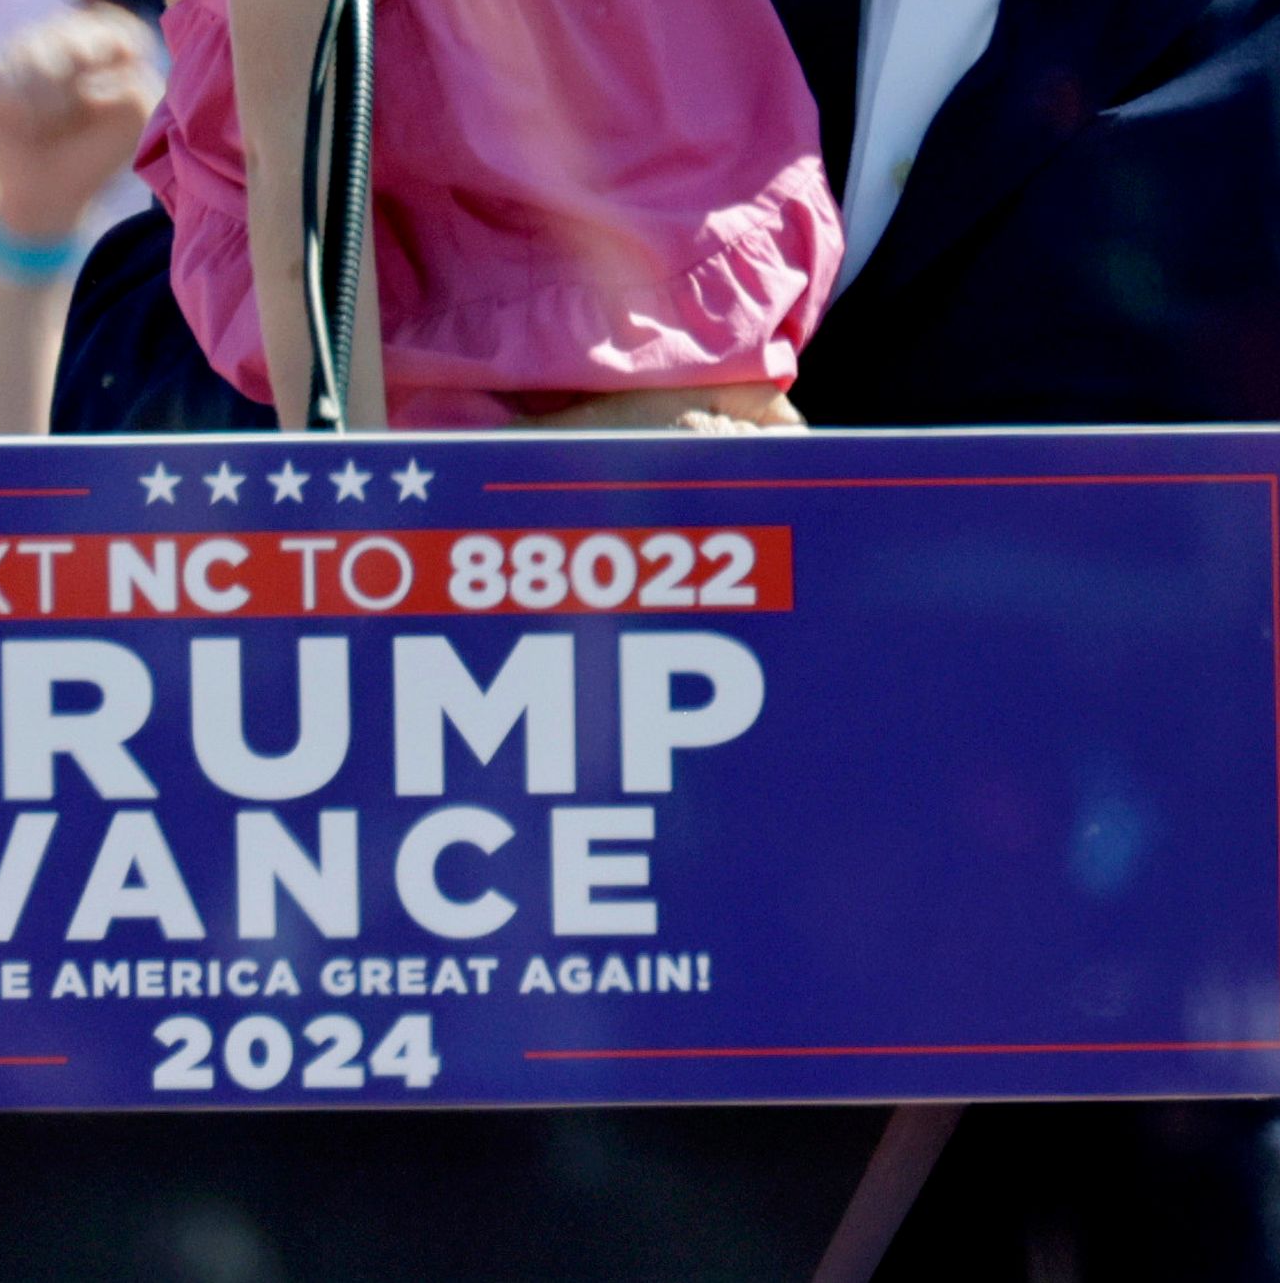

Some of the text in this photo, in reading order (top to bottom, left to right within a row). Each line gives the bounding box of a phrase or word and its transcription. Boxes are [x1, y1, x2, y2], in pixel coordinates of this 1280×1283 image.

[109, 538, 251, 613] NC
[281, 536, 413, 610] TO
[449, 533, 757, 609] 88022
[51, 958, 301, 999] AMERICA
[321, 956, 498, 997] GREAT
[519, 954, 712, 995] AGAIN!
[152, 1014, 439, 1091] 2024
